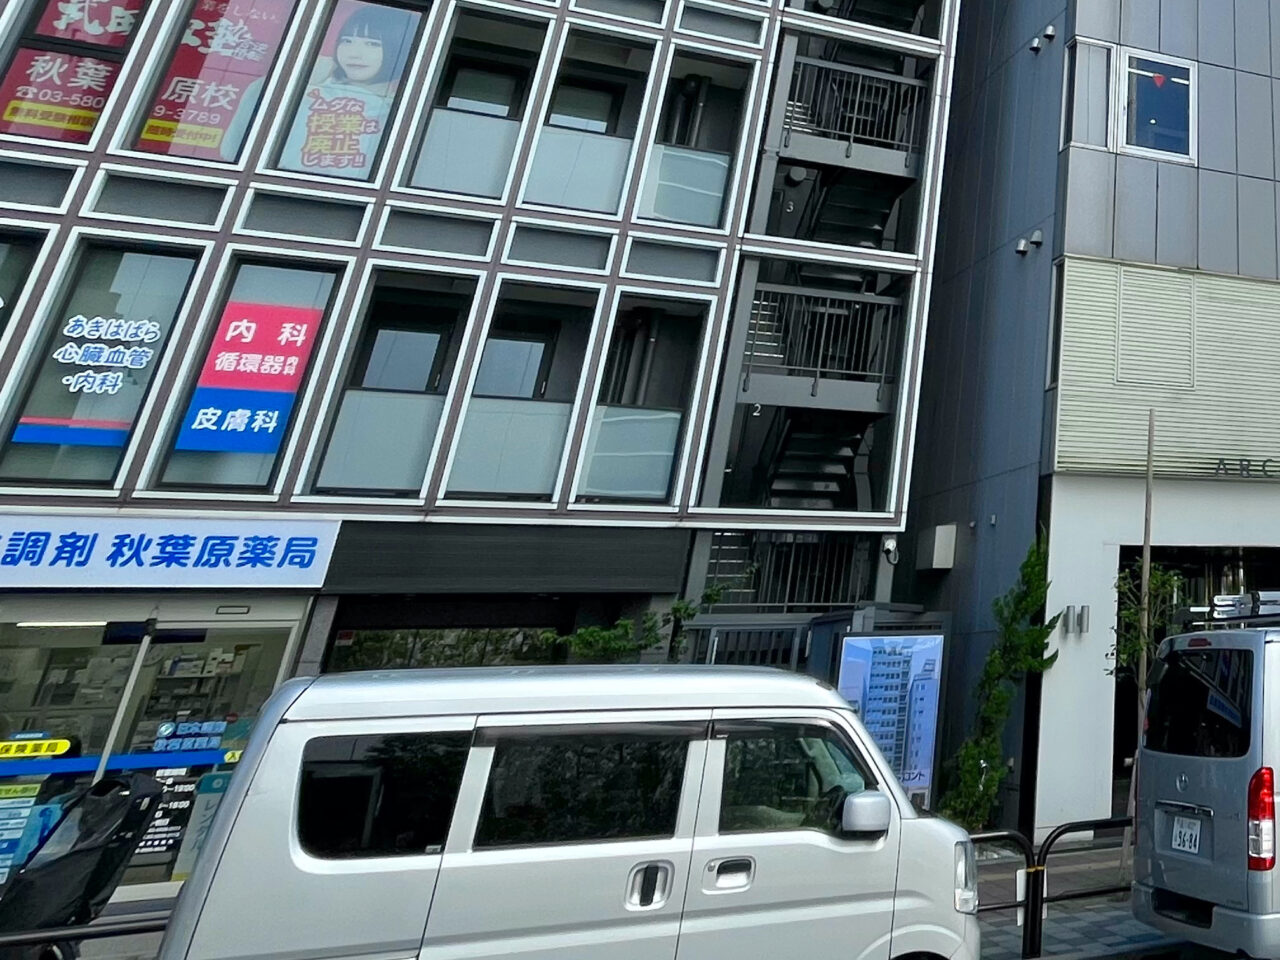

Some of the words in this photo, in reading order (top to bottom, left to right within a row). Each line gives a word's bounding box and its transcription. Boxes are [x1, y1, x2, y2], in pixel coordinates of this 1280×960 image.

[26, 54, 114, 92] 秋葉
[161, 76, 240, 111] 原校
[311, 98, 363, 113] ムダな
[307, 112, 378, 134] 授業は
[63, 314, 161, 342] あきはばら
[52, 341, 154, 369] 心臓血管
[191, 406, 281, 434] 皮膚科
[0, 531, 99, 568] 調剤
[105, 532, 319, 569] 秋葉原薬局
